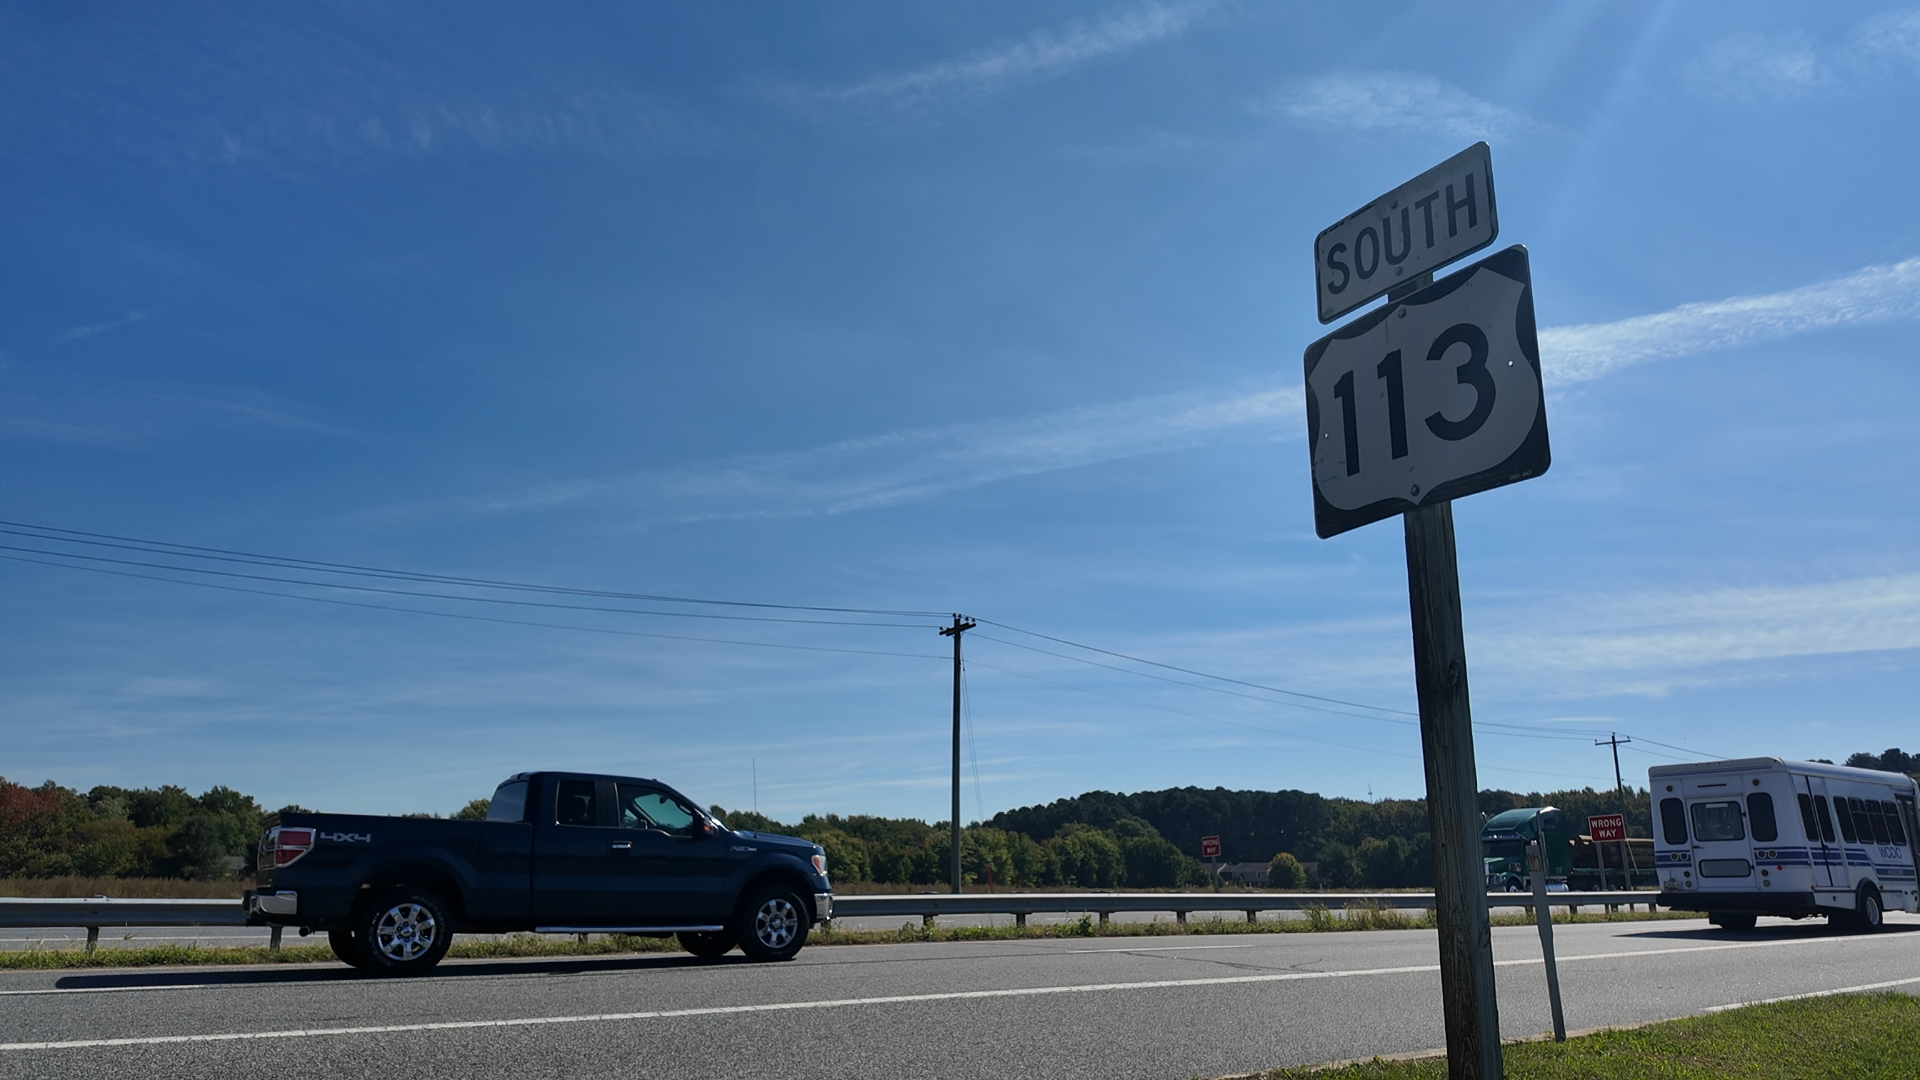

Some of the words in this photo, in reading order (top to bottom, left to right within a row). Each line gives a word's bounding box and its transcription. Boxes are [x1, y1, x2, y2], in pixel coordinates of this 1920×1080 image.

[1327, 172, 1478, 295] SOUTH
[1333, 322, 1497, 477] 113
[1591, 818, 1622, 828] WRONG
[1599, 829, 1617, 838] WAY
